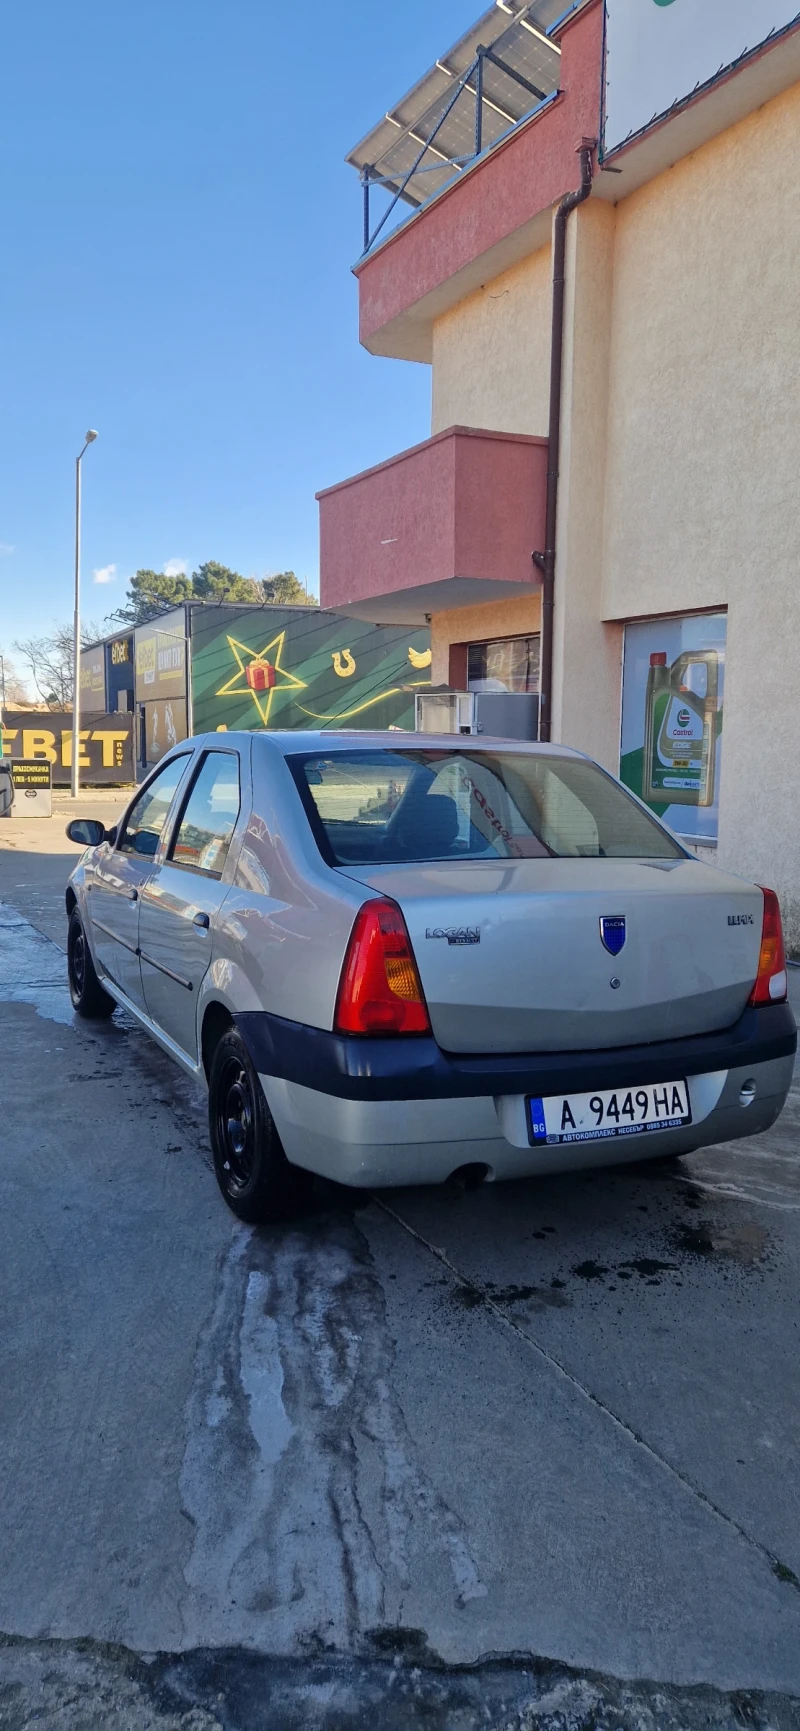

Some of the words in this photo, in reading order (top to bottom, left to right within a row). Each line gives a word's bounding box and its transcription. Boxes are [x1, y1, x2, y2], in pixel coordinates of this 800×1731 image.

[425, 926, 481, 939] LOGAN
[560, 1099, 576, 1130] A
[589, 1090, 649, 1126] 9449
[652, 1086, 685, 1117] HA
[533, 1123, 545, 1133] BG
[562, 1128, 616, 1142] АВТОКОМПЛЕКС
[618, 1124, 644, 1135] НЕСЕБЪР
